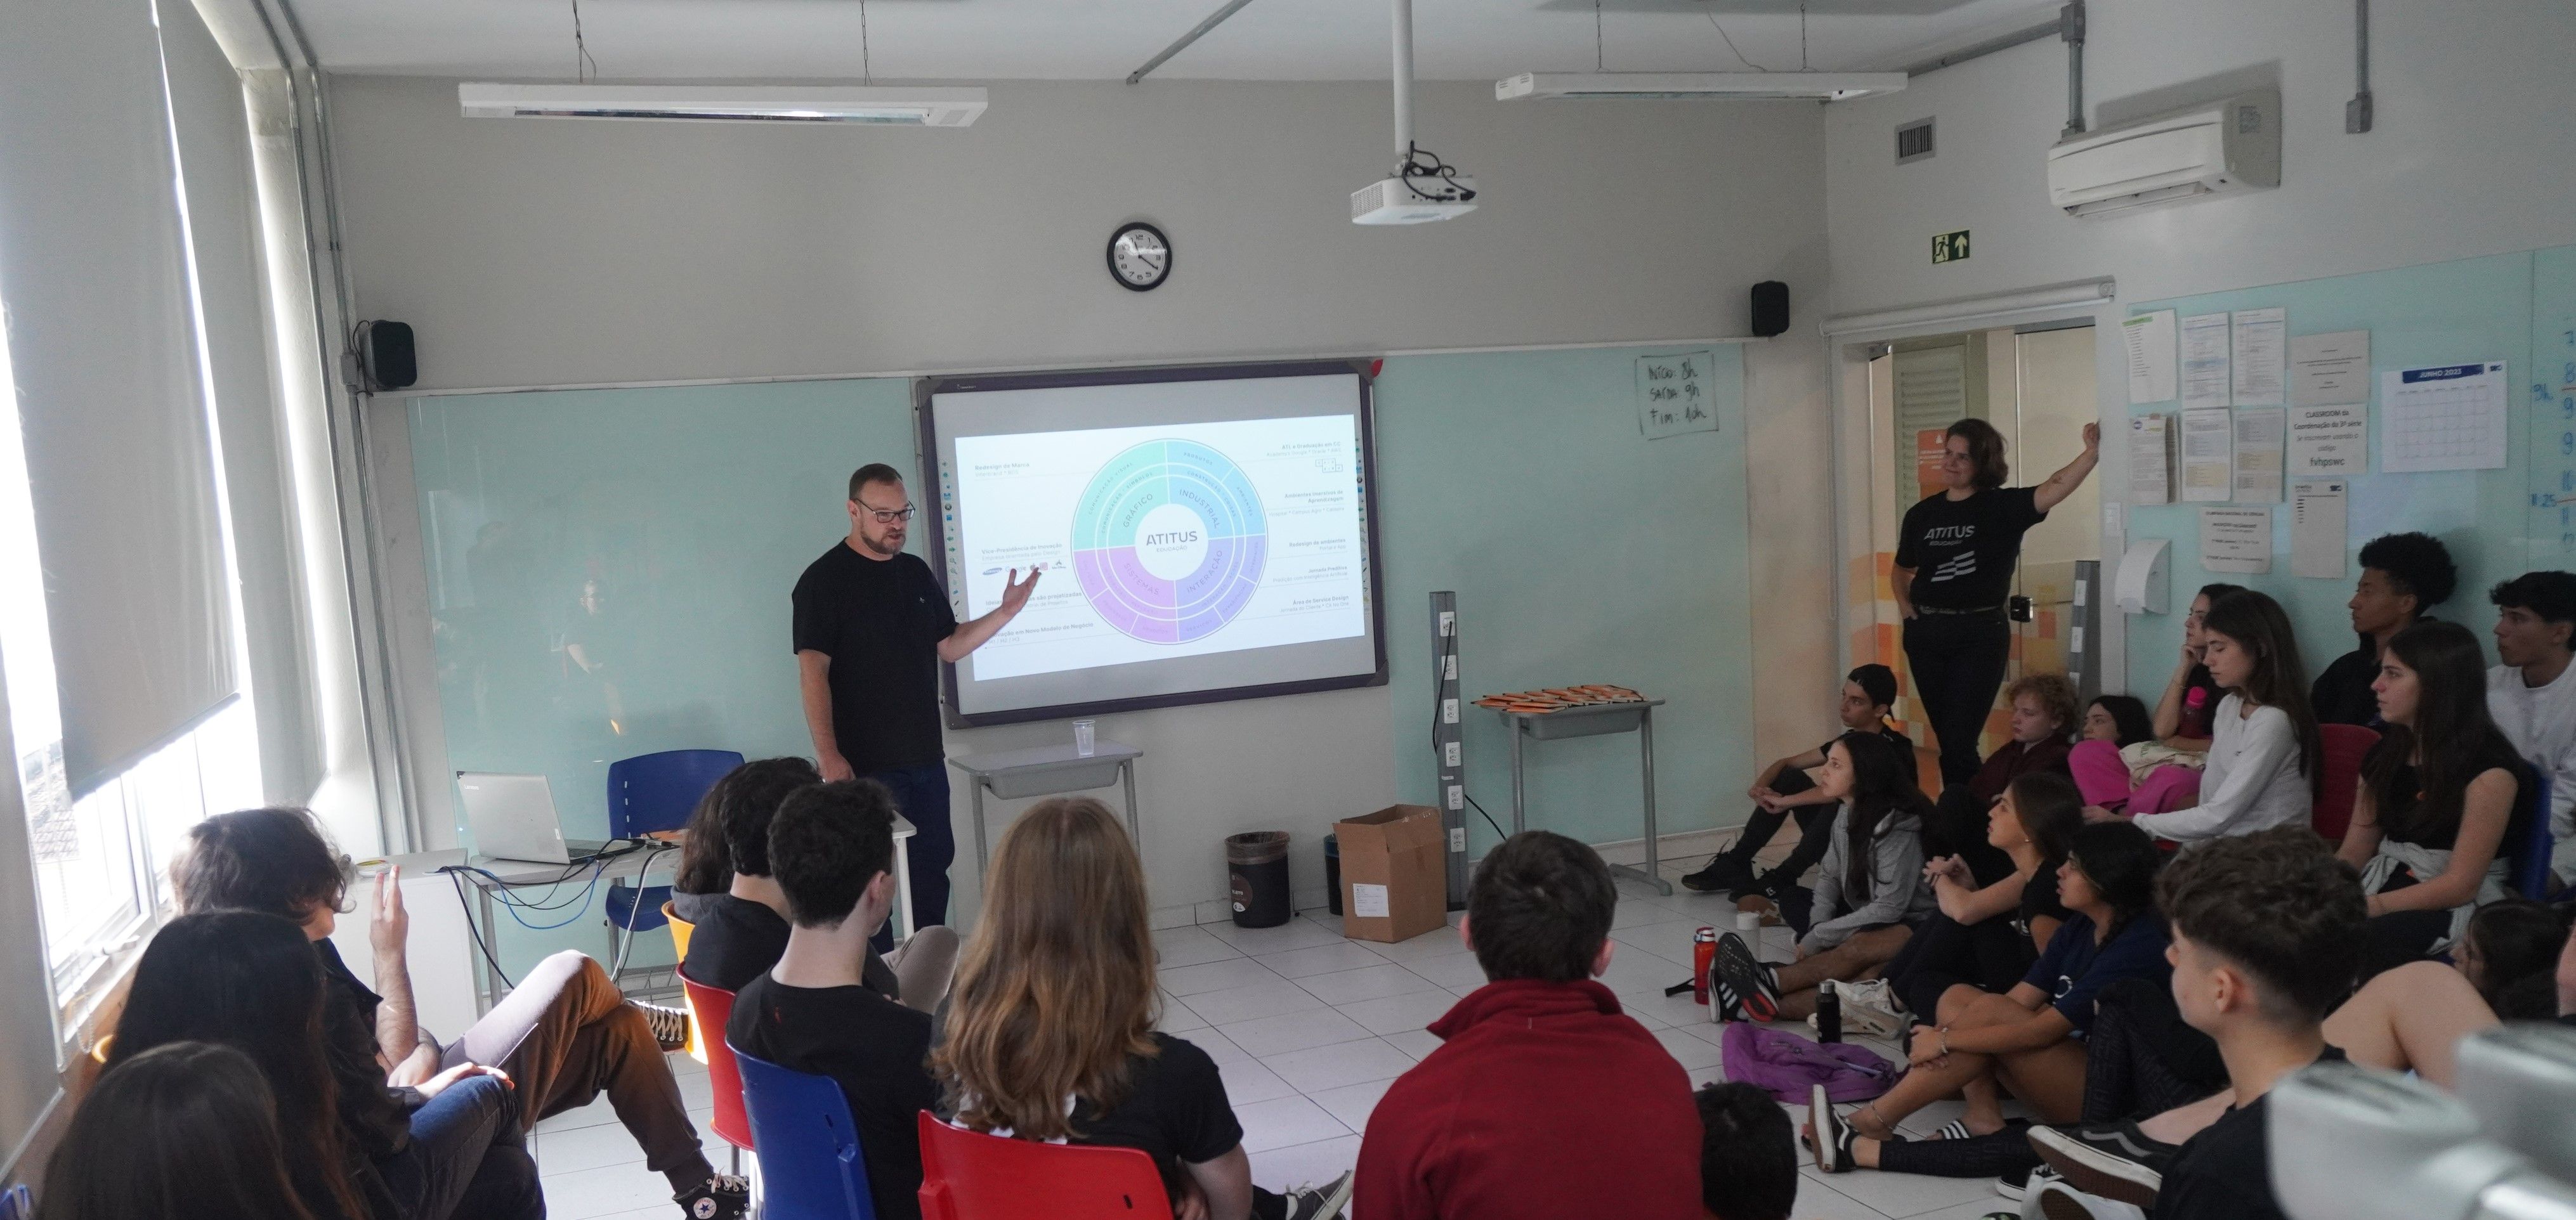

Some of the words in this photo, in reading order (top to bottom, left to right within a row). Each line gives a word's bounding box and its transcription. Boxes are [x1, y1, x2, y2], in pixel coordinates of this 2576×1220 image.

[1123, 493, 1153, 528] GRÁFICO
[1179, 488, 1220, 529] INDUSTRIAL
[1146, 531, 1198, 545] ATITUS
[1924, 525, 1975, 540] ATITUS
[1123, 562, 1160, 595] SISTEMAS
[1187, 550, 1222, 594] INTERAÇÃO
